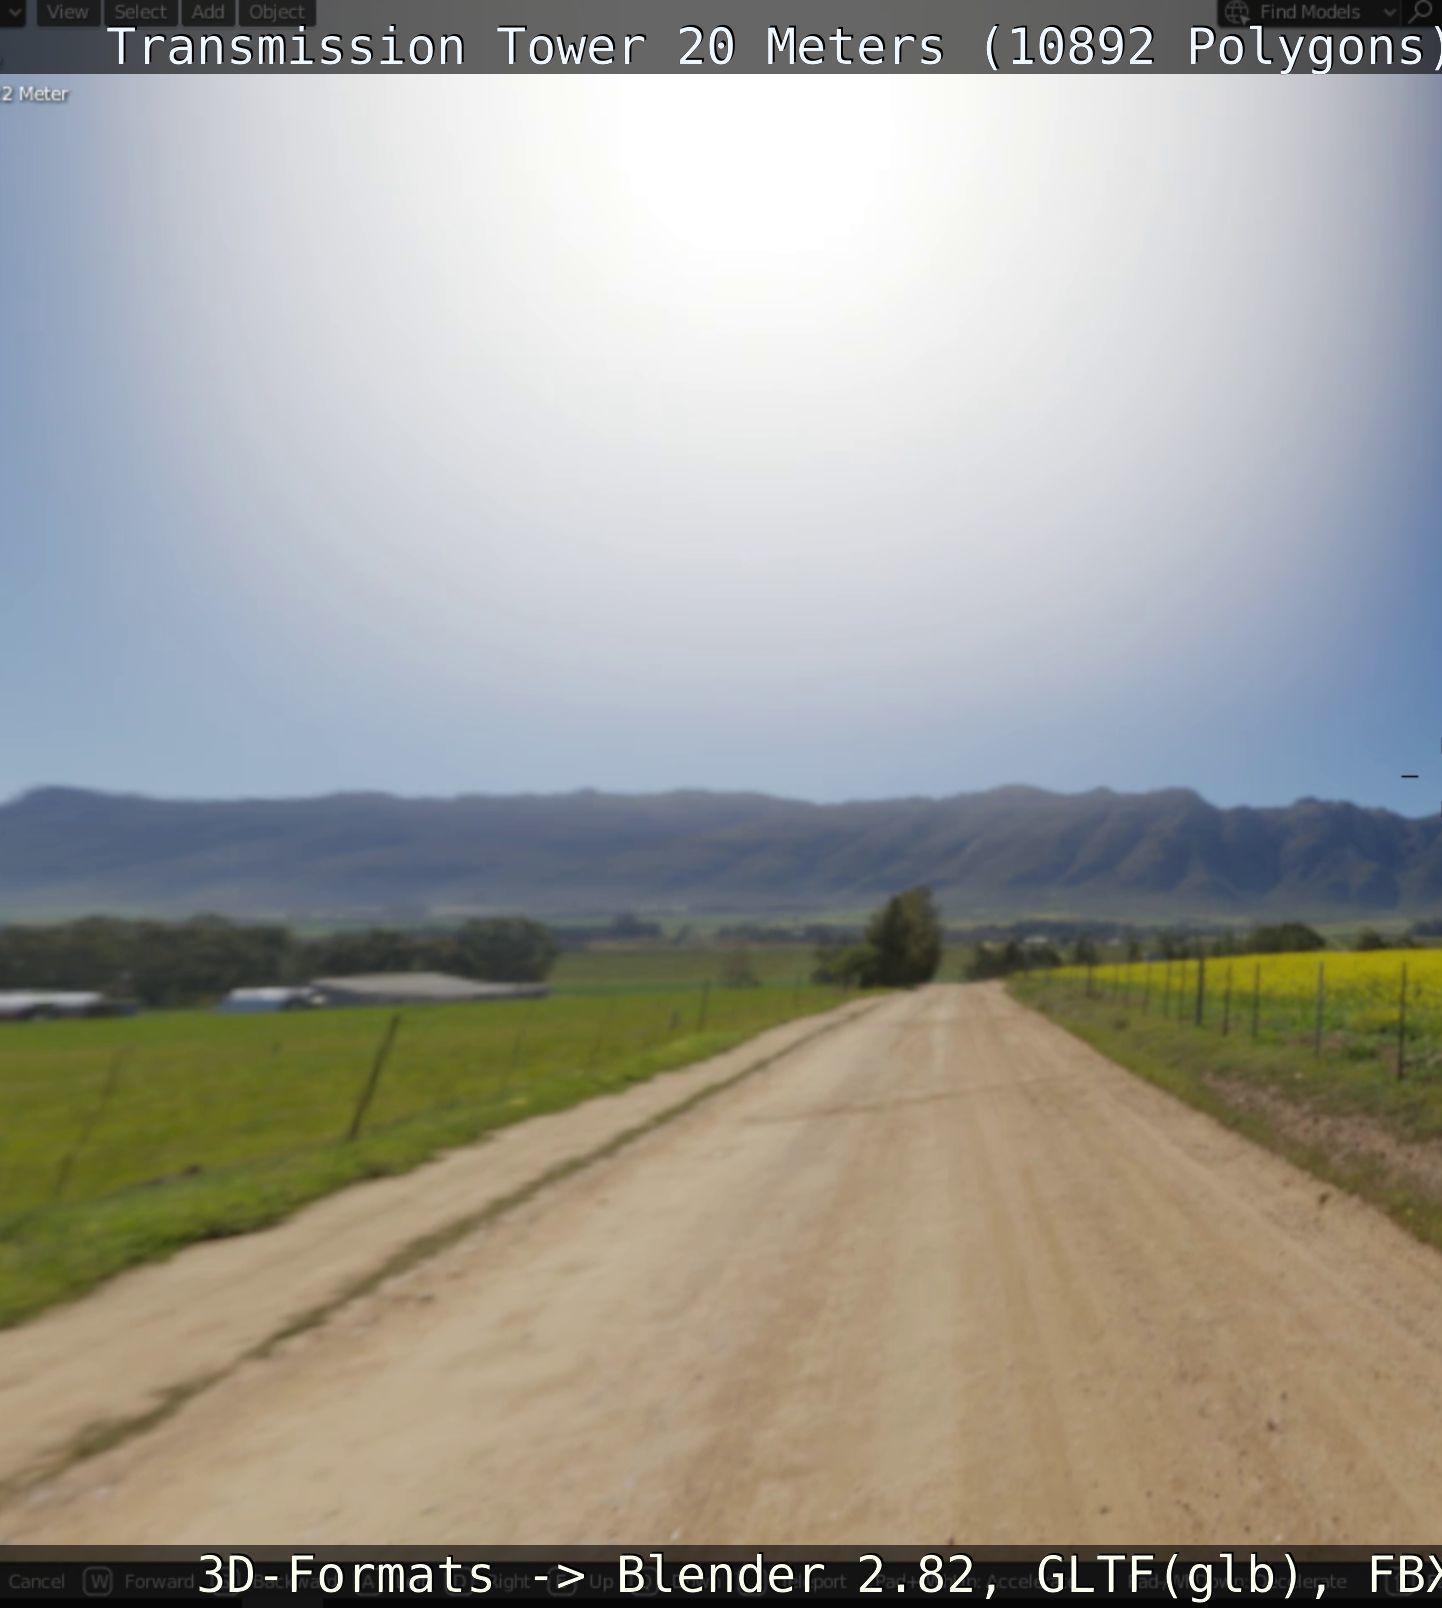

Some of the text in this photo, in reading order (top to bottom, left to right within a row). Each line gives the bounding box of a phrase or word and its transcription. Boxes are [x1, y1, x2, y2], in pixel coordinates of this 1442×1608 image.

[47, 4, 88, 19] View
[116, 4, 167, 19] Select
[192, 4, 224, 19] Add
[249, 4, 305, 23] Object
[1262, 4, 1361, 19] Find Models
[19, 86, 68, 101] Meter
[8, 1573, 65, 1589] Cancel
[90, 1573, 195, 1589] W Forward
[589, 1573, 614, 1593] Up
